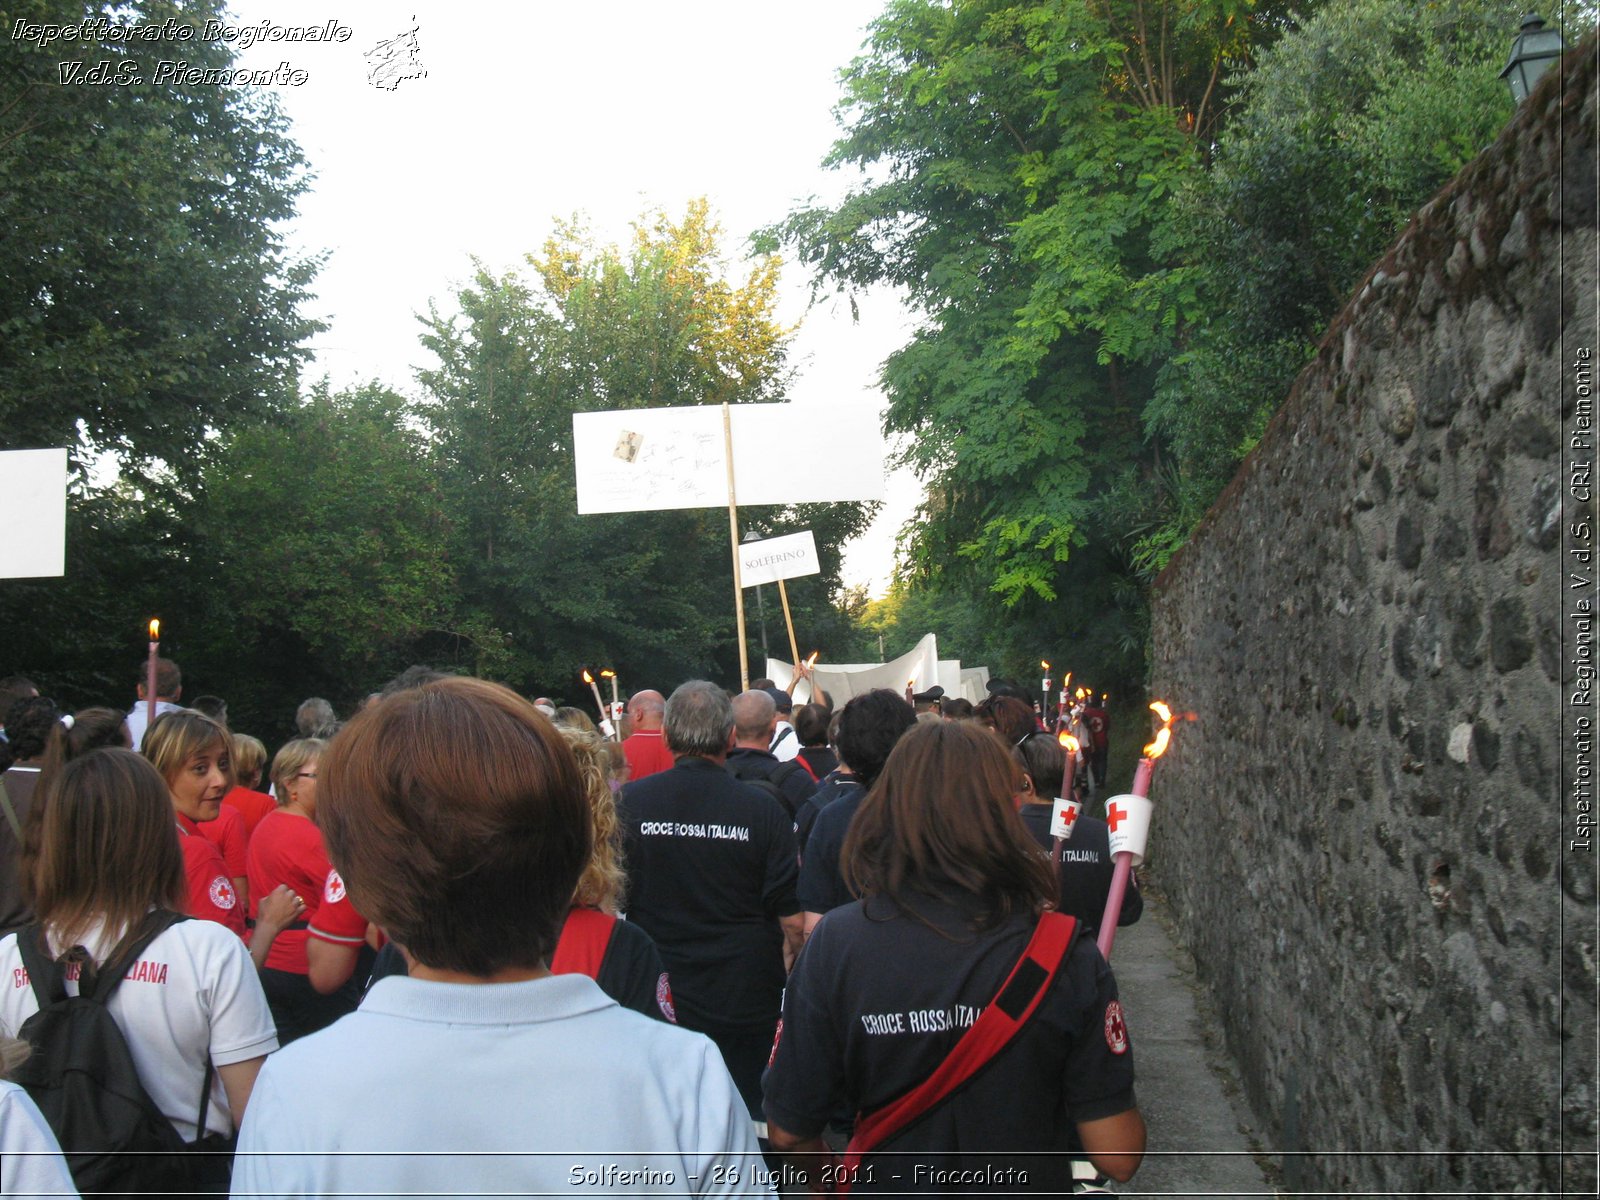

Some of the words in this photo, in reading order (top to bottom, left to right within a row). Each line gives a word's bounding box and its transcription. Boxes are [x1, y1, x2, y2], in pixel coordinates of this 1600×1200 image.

[744, 549, 806, 571] SOLFERINO
[640, 821, 674, 836] CROCE
[674, 822, 706, 838] ROSSA
[707, 824, 750, 842] ITALIANA
[1062, 849, 1100, 864] ITALIANA
[861, 1012, 906, 1036] CROCE
[908, 1009, 953, 1033] ROSSA
